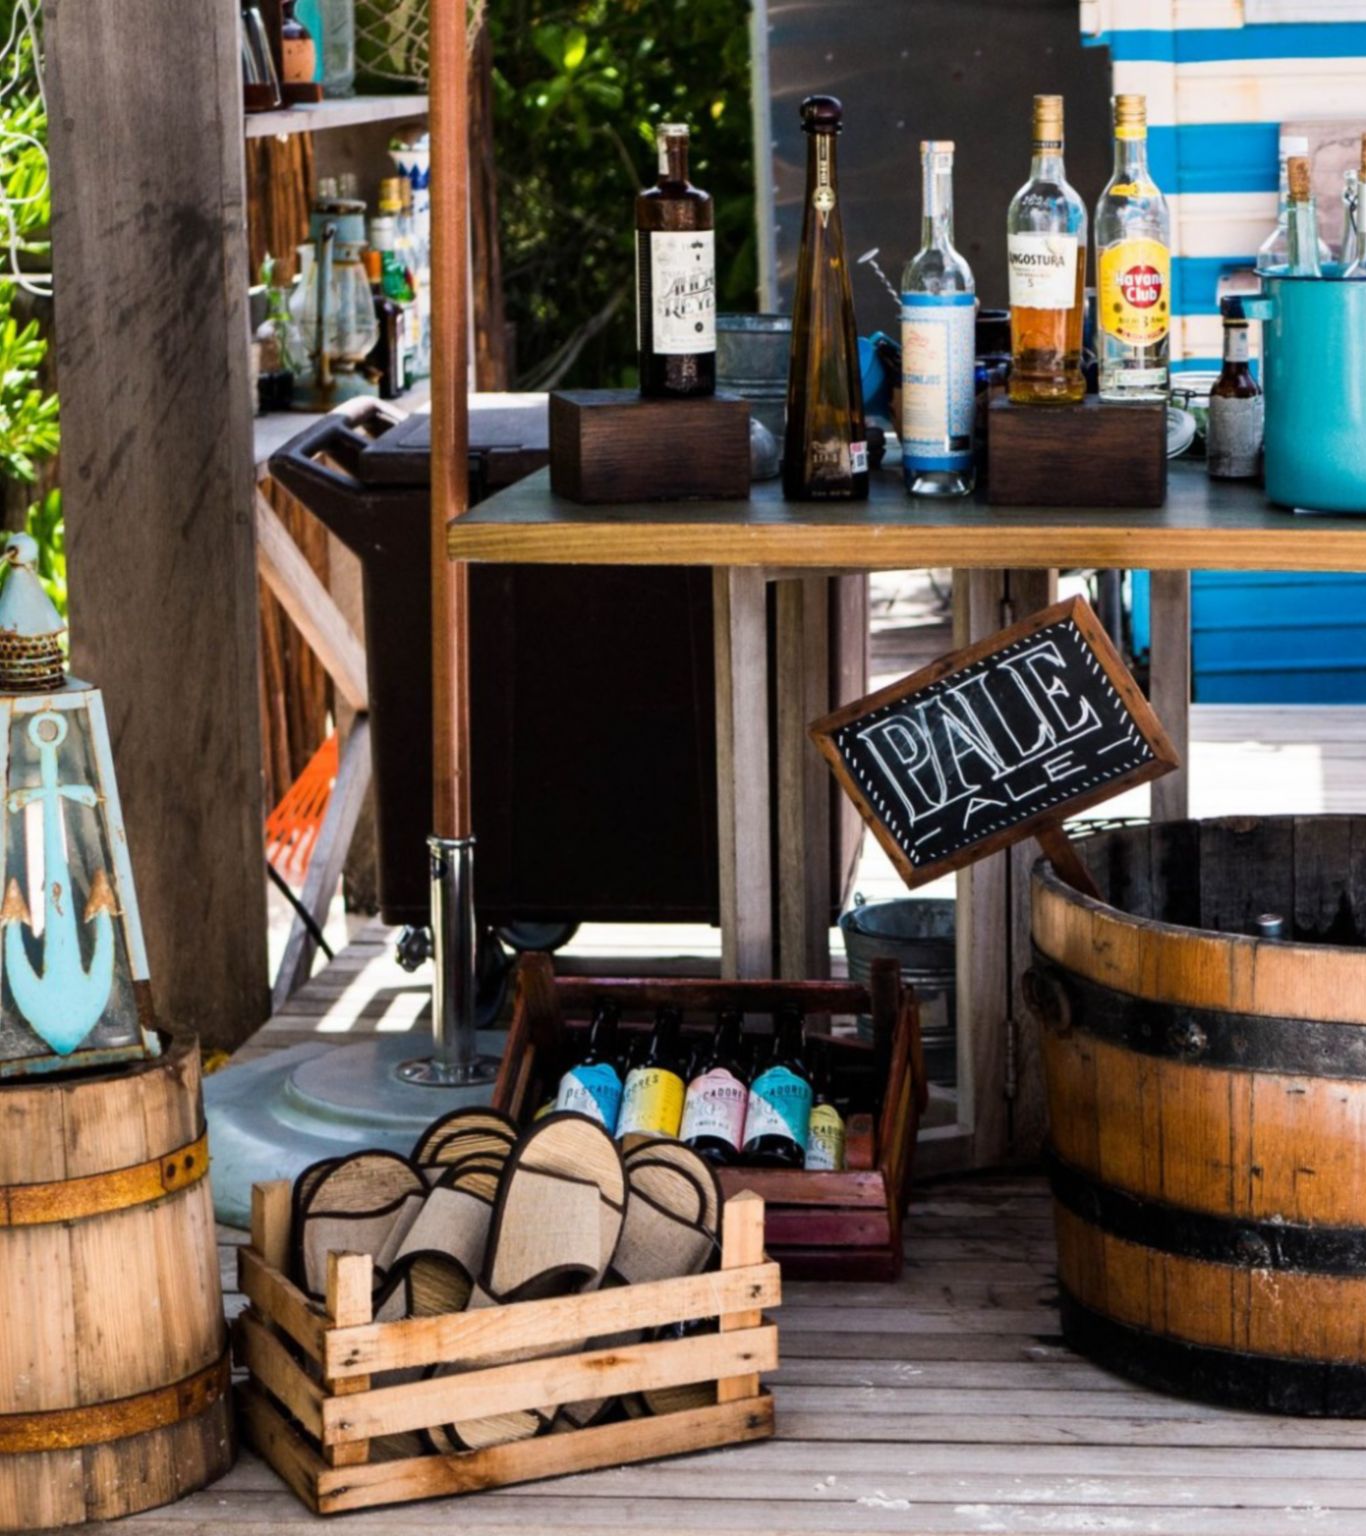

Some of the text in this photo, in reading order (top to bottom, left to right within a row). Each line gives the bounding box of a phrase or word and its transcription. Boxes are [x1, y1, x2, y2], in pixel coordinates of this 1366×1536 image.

[1126, 286, 1158, 302] Club
[857, 640, 1102, 827] PALE
[963, 751, 1087, 830] ALE
